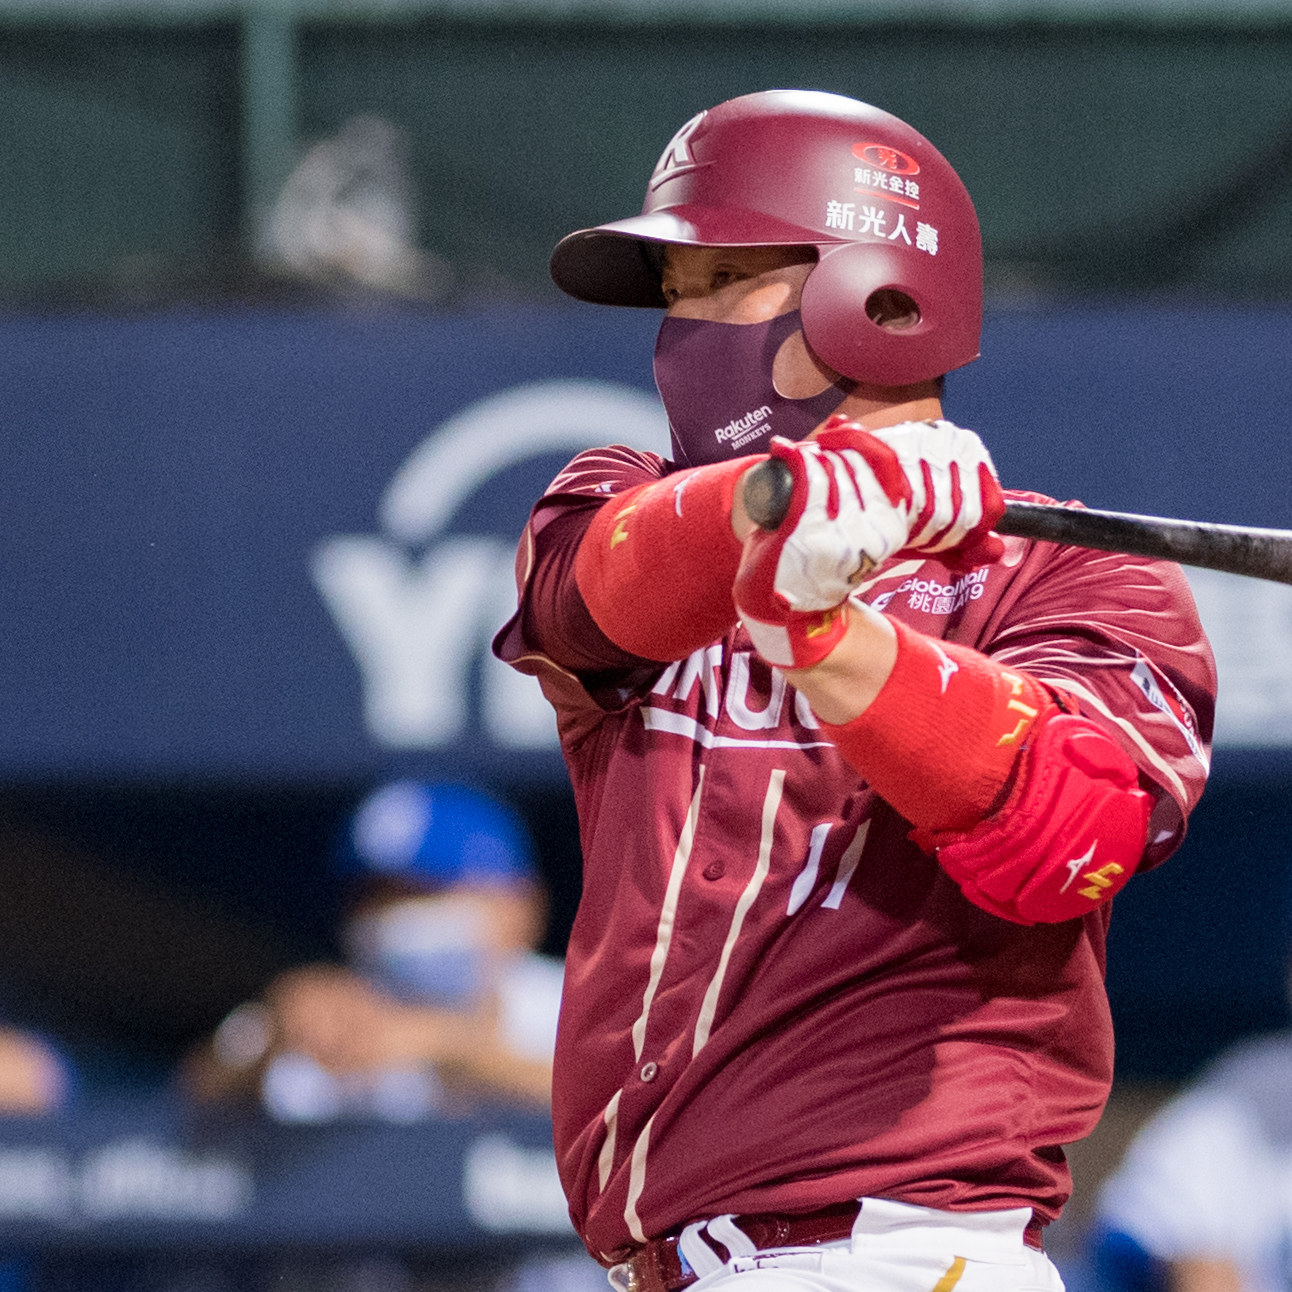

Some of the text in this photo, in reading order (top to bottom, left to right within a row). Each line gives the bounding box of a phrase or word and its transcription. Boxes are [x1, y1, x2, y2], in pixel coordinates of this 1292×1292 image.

[853, 167, 920, 200] 新光金控
[825, 199, 939, 256] 新光人壽
[714, 405, 773, 444] Rakuten
[731, 423, 772, 450] MONKEYS
